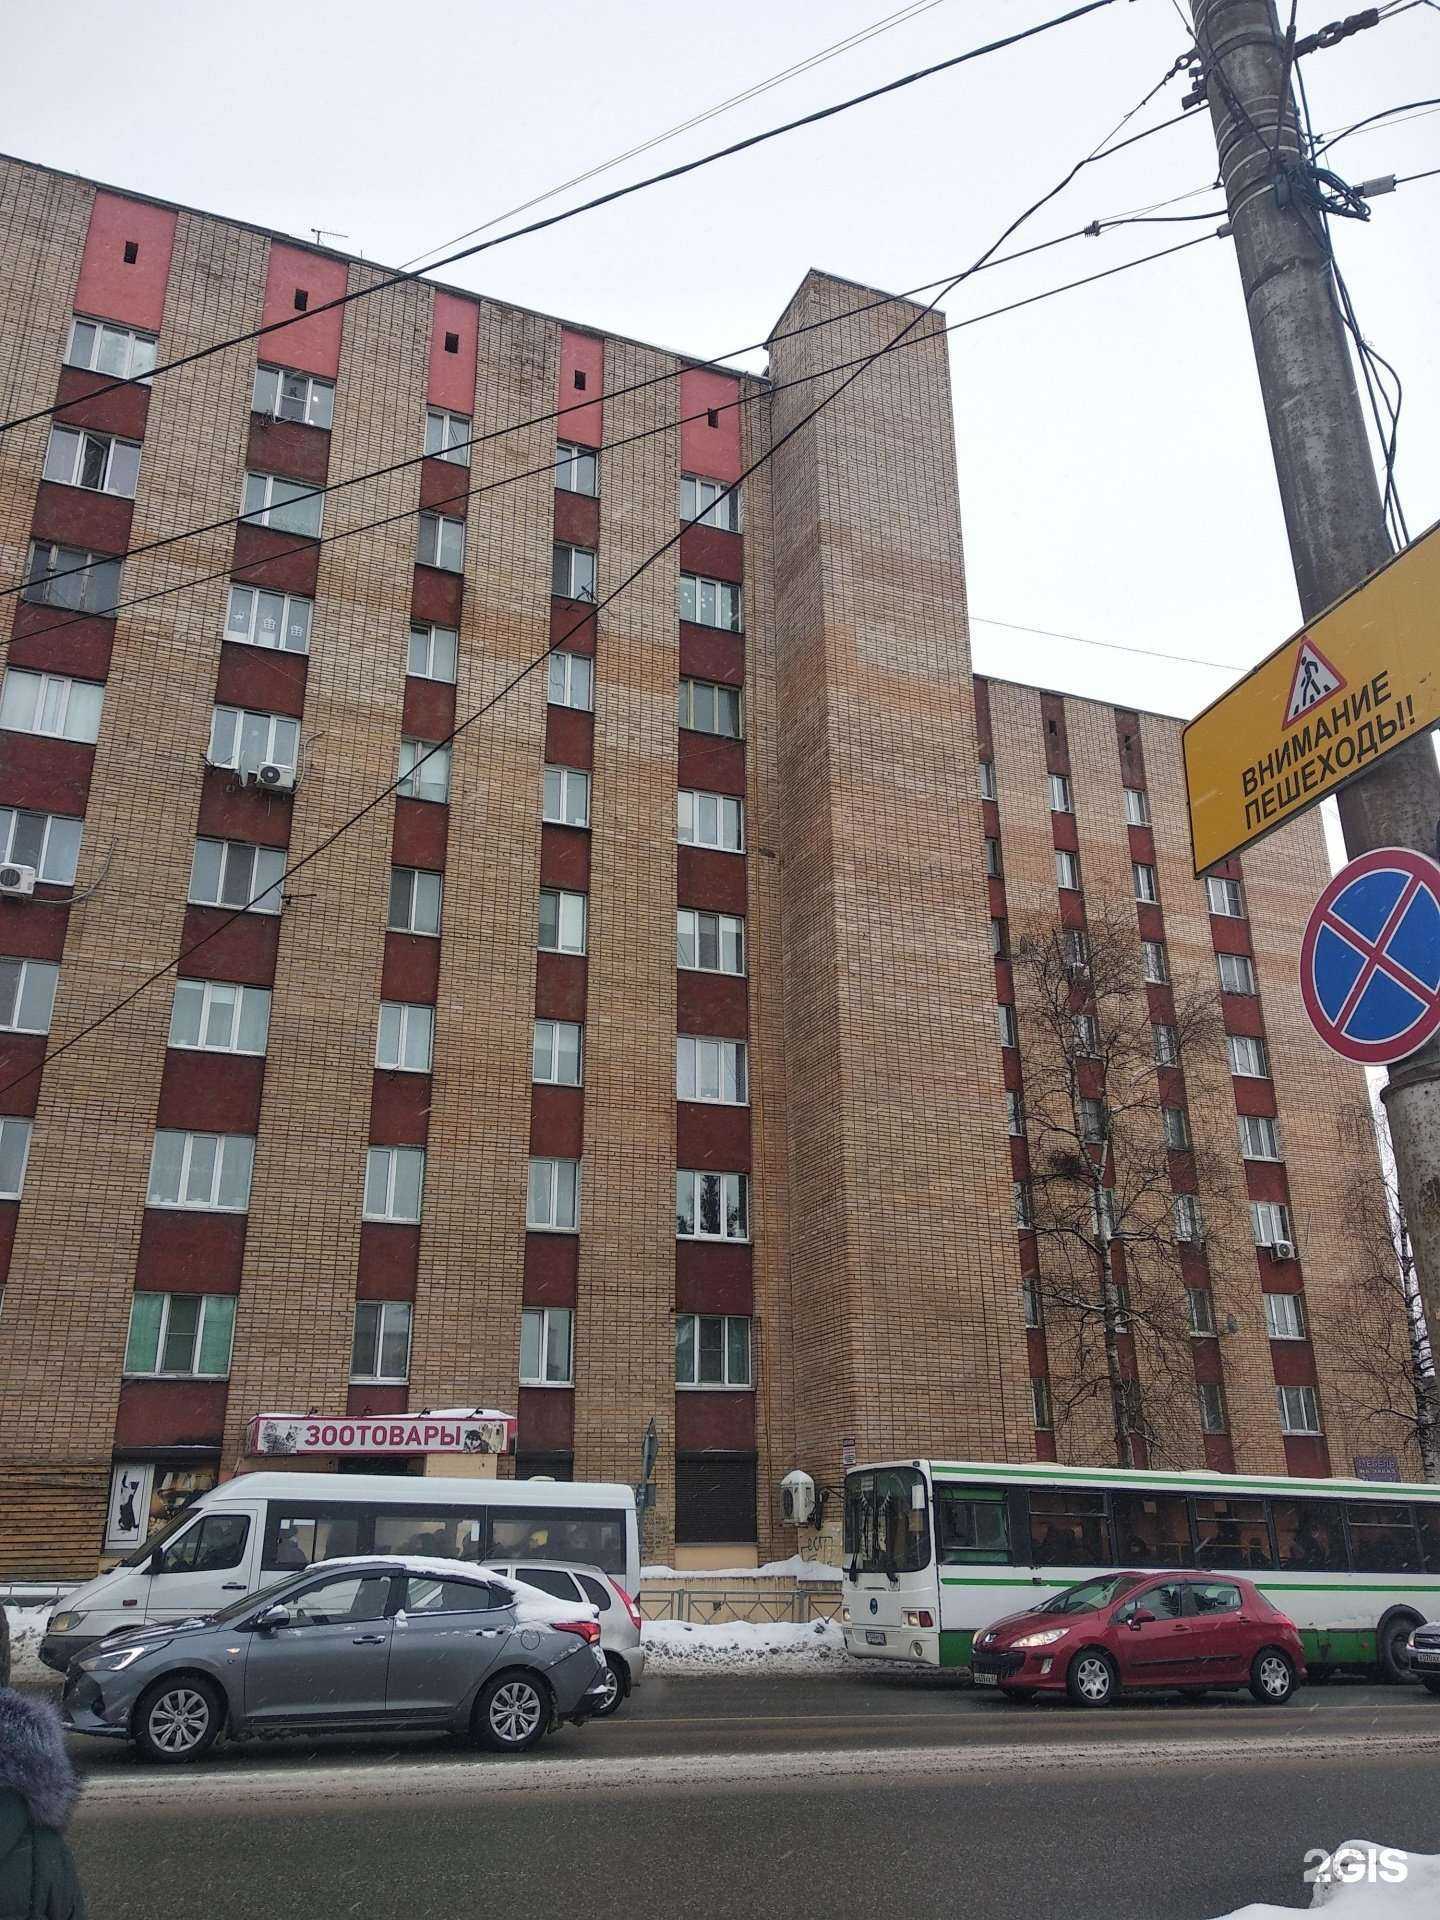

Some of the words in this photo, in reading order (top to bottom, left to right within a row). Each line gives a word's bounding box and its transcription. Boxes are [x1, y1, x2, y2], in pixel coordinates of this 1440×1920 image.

[1242, 670, 1392, 797] ВНИМАНИЕ
[1244, 694, 1416, 830] ПЕШЕХОДЫ!
[304, 1424, 461, 1446] ЗООТОВАРЫ
